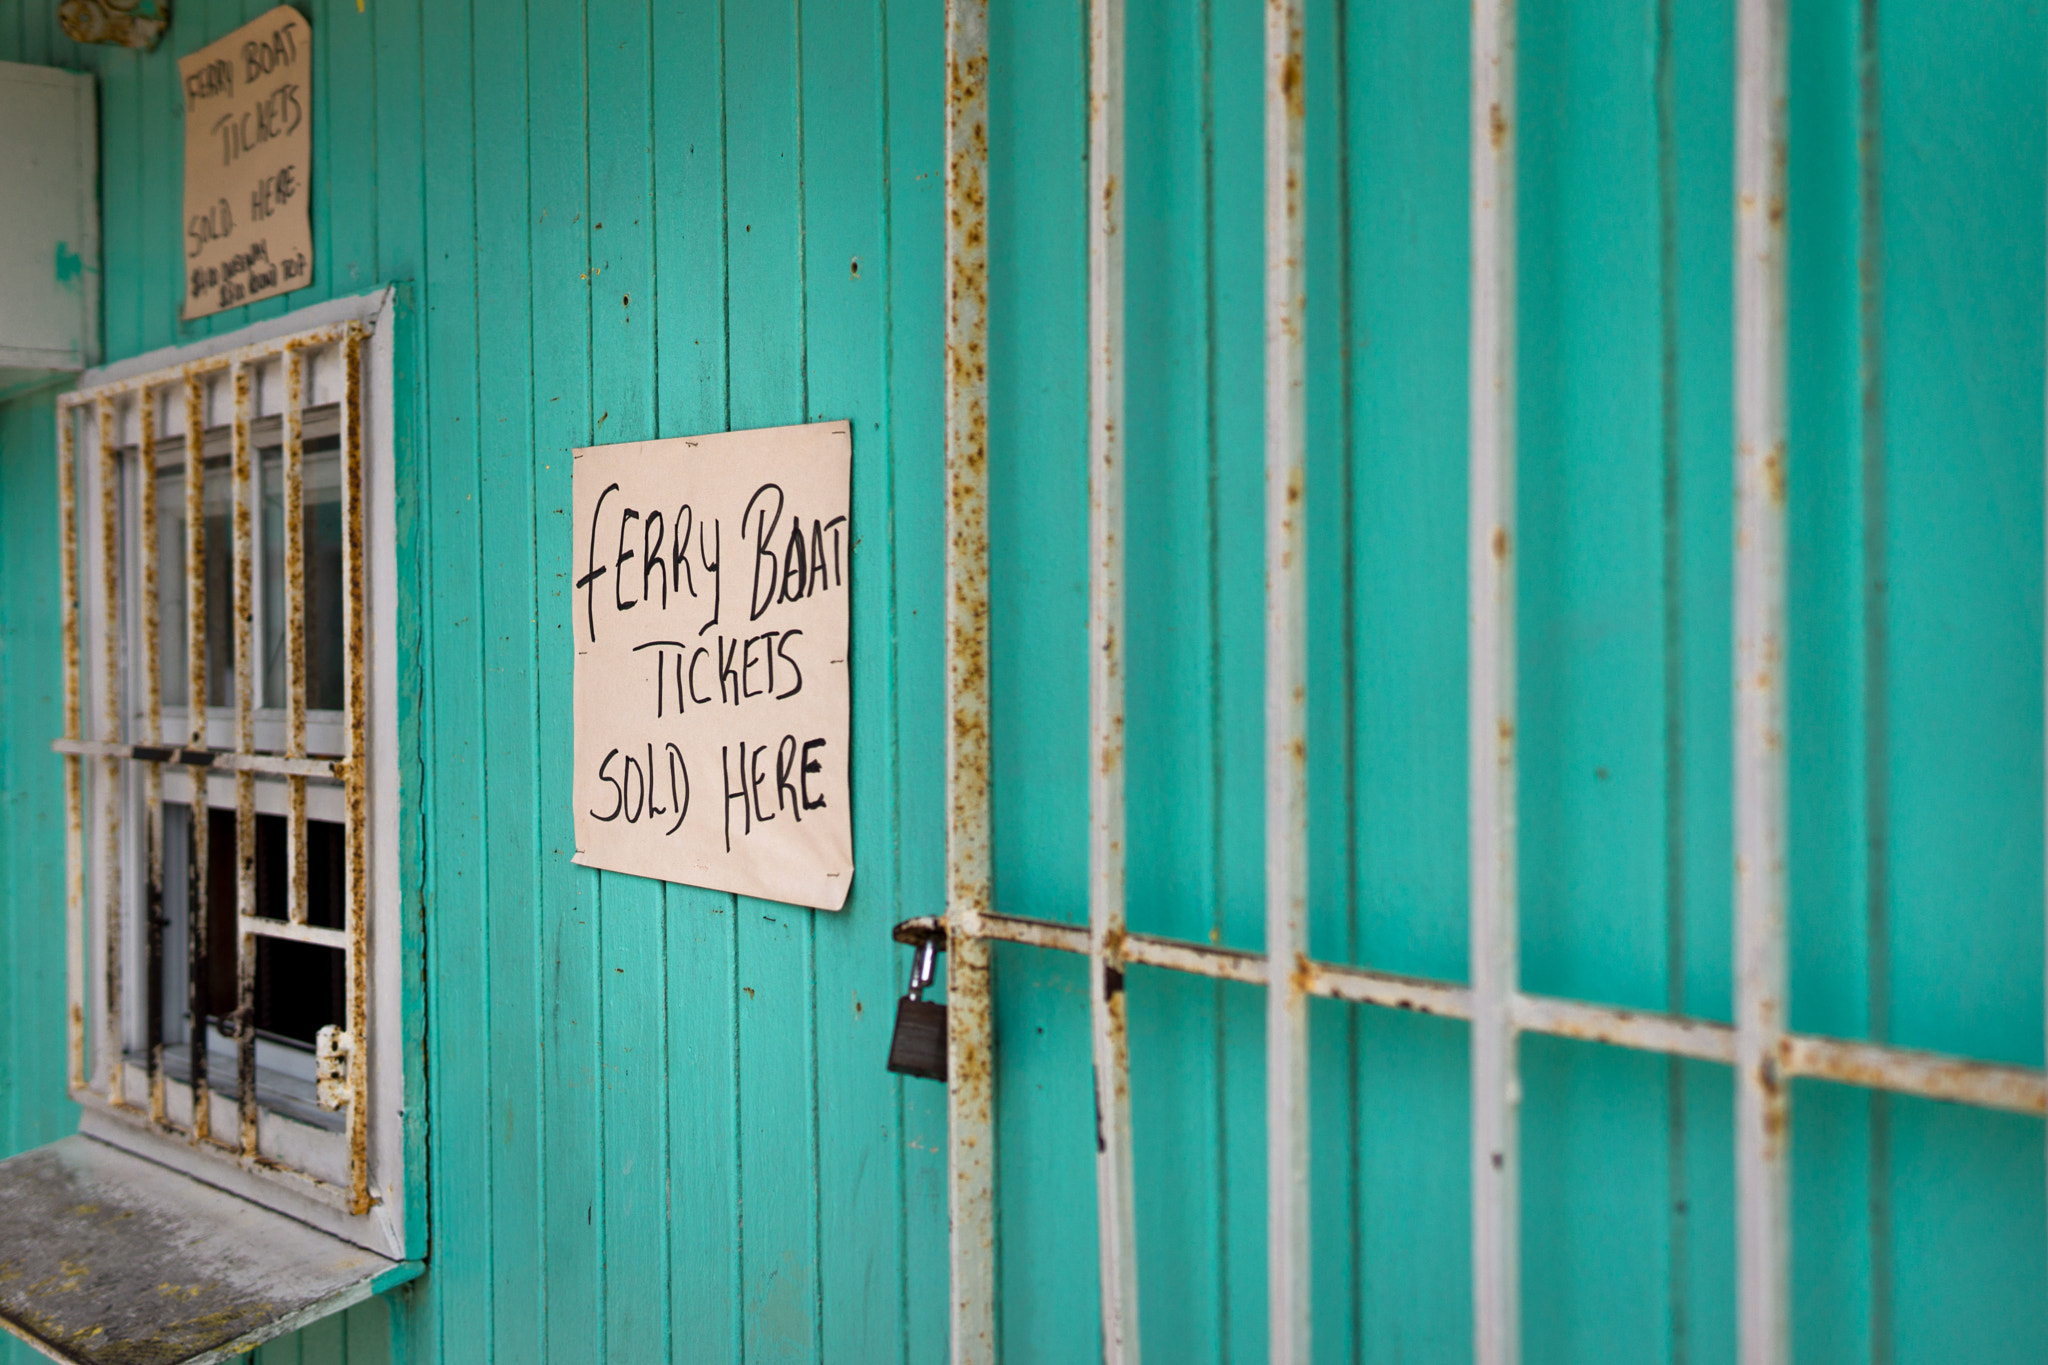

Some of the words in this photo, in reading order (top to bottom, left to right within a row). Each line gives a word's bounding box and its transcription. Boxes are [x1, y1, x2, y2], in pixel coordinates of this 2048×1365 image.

[241, 22, 297, 84] BOAT
[210, 84, 302, 166] TICKETS
[188, 198, 234, 258] SOLD
[252, 164, 296, 221] HERE
[575, 482, 720, 643] FERRY
[632, 628, 804, 719] TICKETS
[589, 742, 690, 836] SOLD
[722, 734, 827, 851] HERE
